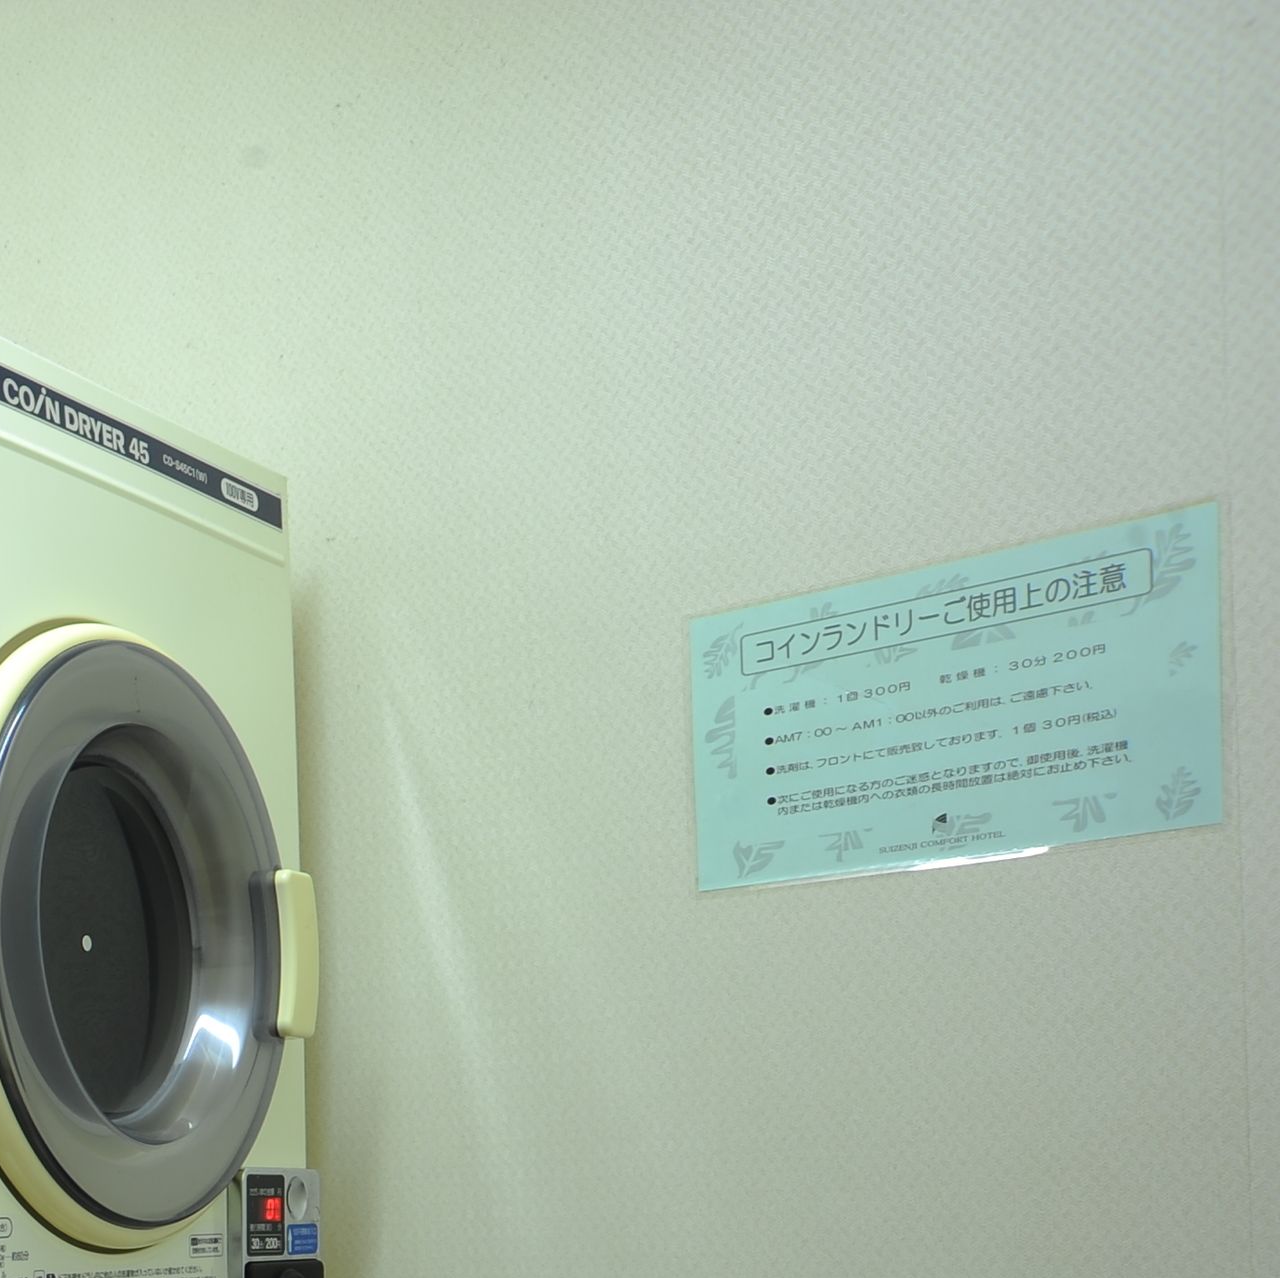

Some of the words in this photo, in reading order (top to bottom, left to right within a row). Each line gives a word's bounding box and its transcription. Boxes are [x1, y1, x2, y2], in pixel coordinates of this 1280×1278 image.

[65, 407, 126, 455] DRYER
[128, 438, 150, 465] 45
[756, 563, 1128, 663] コインランドリーご使用上の注意
[971, 830, 1006, 842] HOTEL
